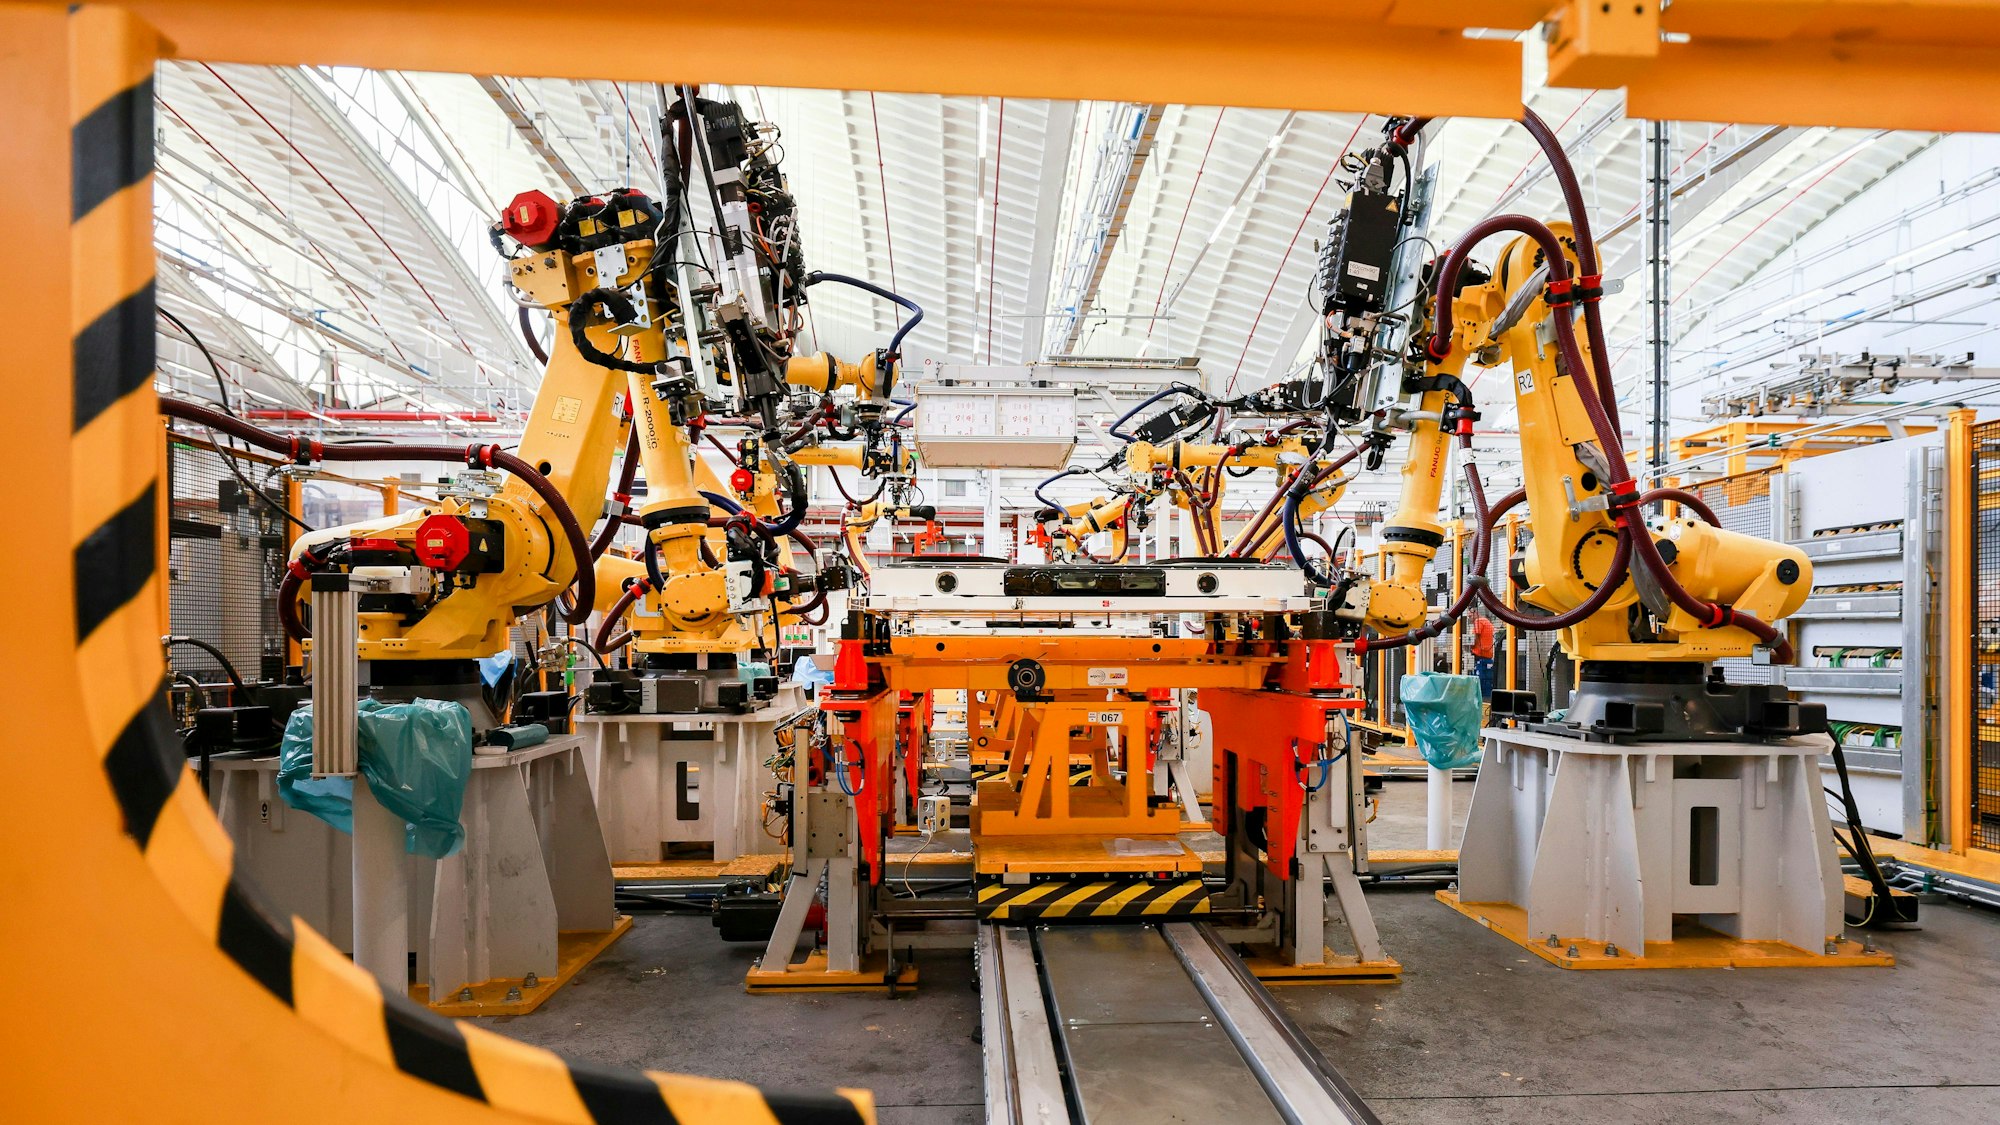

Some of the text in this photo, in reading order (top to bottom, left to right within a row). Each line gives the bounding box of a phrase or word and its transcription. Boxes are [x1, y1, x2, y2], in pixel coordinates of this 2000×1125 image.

[632, 340, 642, 364] FANU
[1518, 374, 1533, 391] R2
[614, 396, 623, 414] R1
[1430, 447, 1441, 478] FANUC
[1101, 714, 1119, 722] 067
